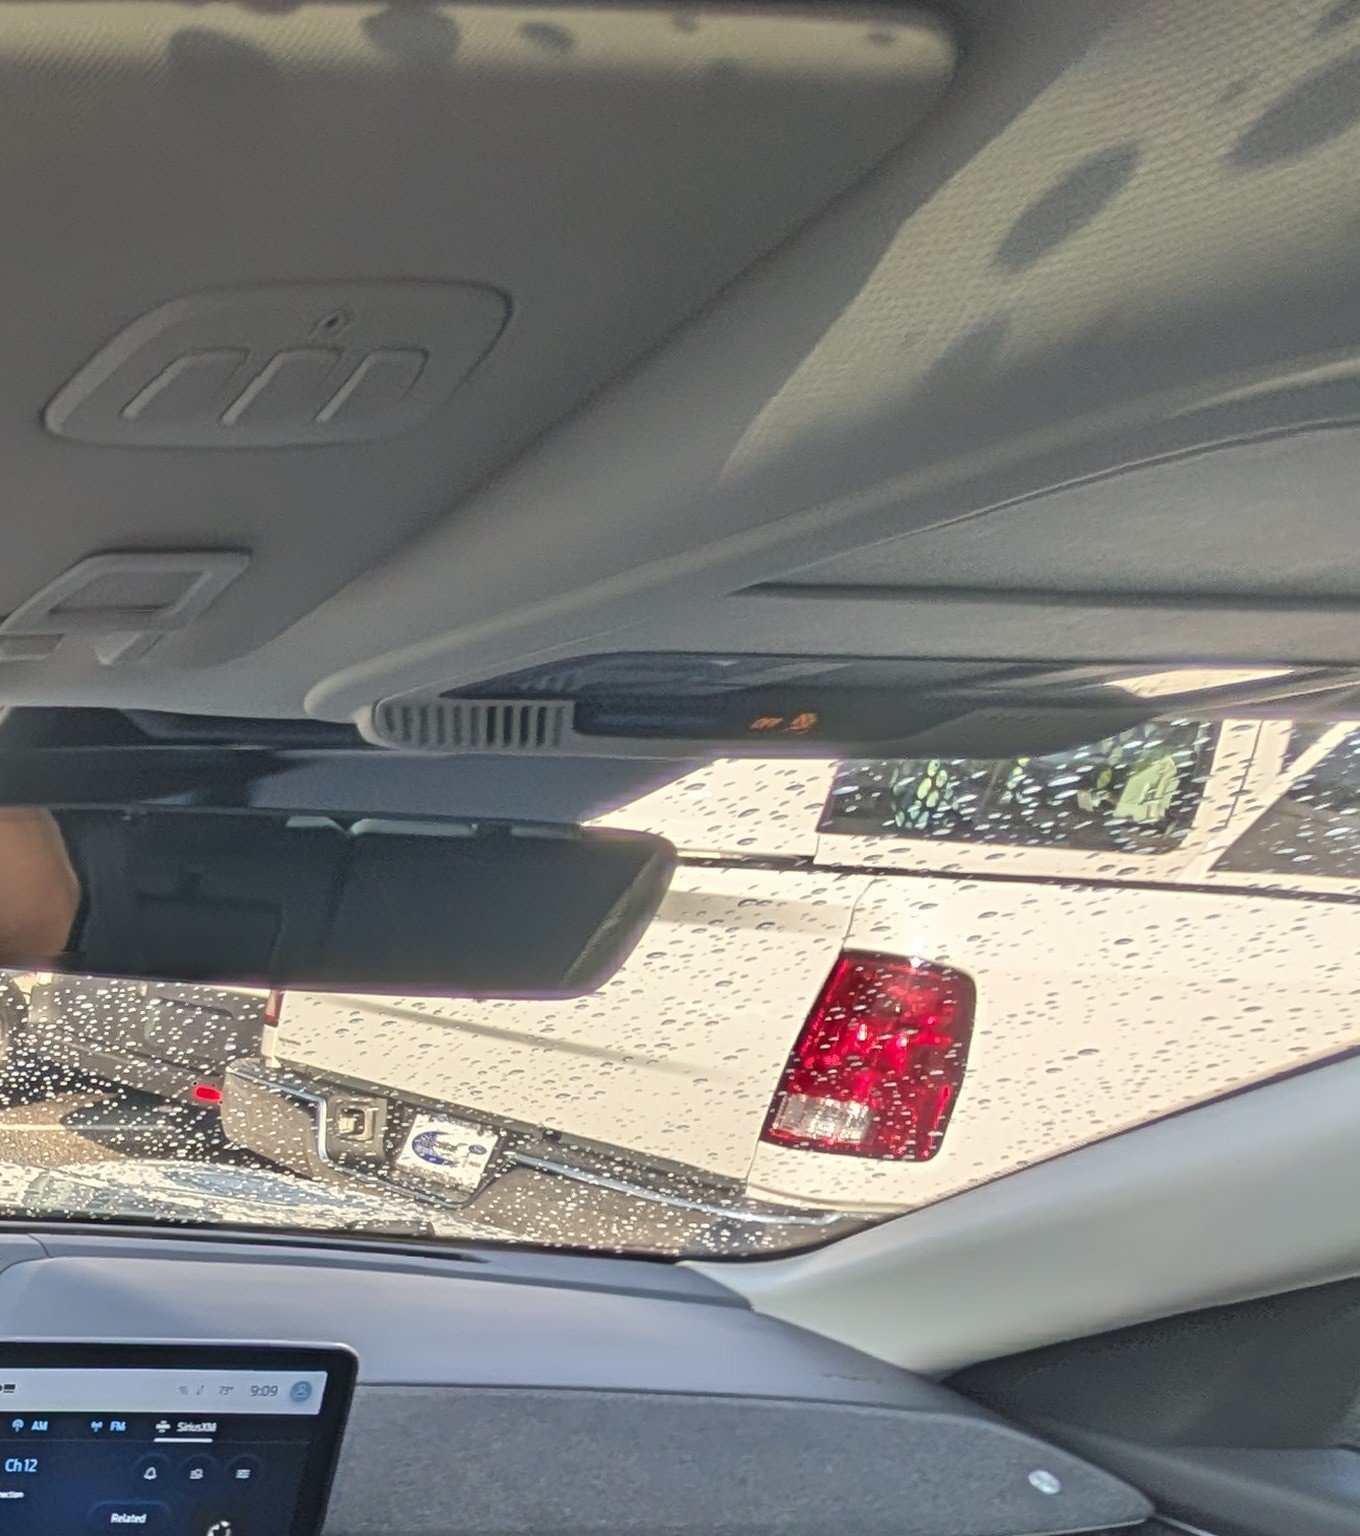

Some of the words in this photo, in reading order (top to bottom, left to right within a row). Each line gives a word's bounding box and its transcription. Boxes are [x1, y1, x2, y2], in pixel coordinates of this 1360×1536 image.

[249, 1385, 279, 1397] 9:09
[31, 1420, 49, 1431] AM
[4, 1458, 23, 1473] Ch
[24, 1458, 39, 1473] 12
[110, 1513, 147, 1524] Related
